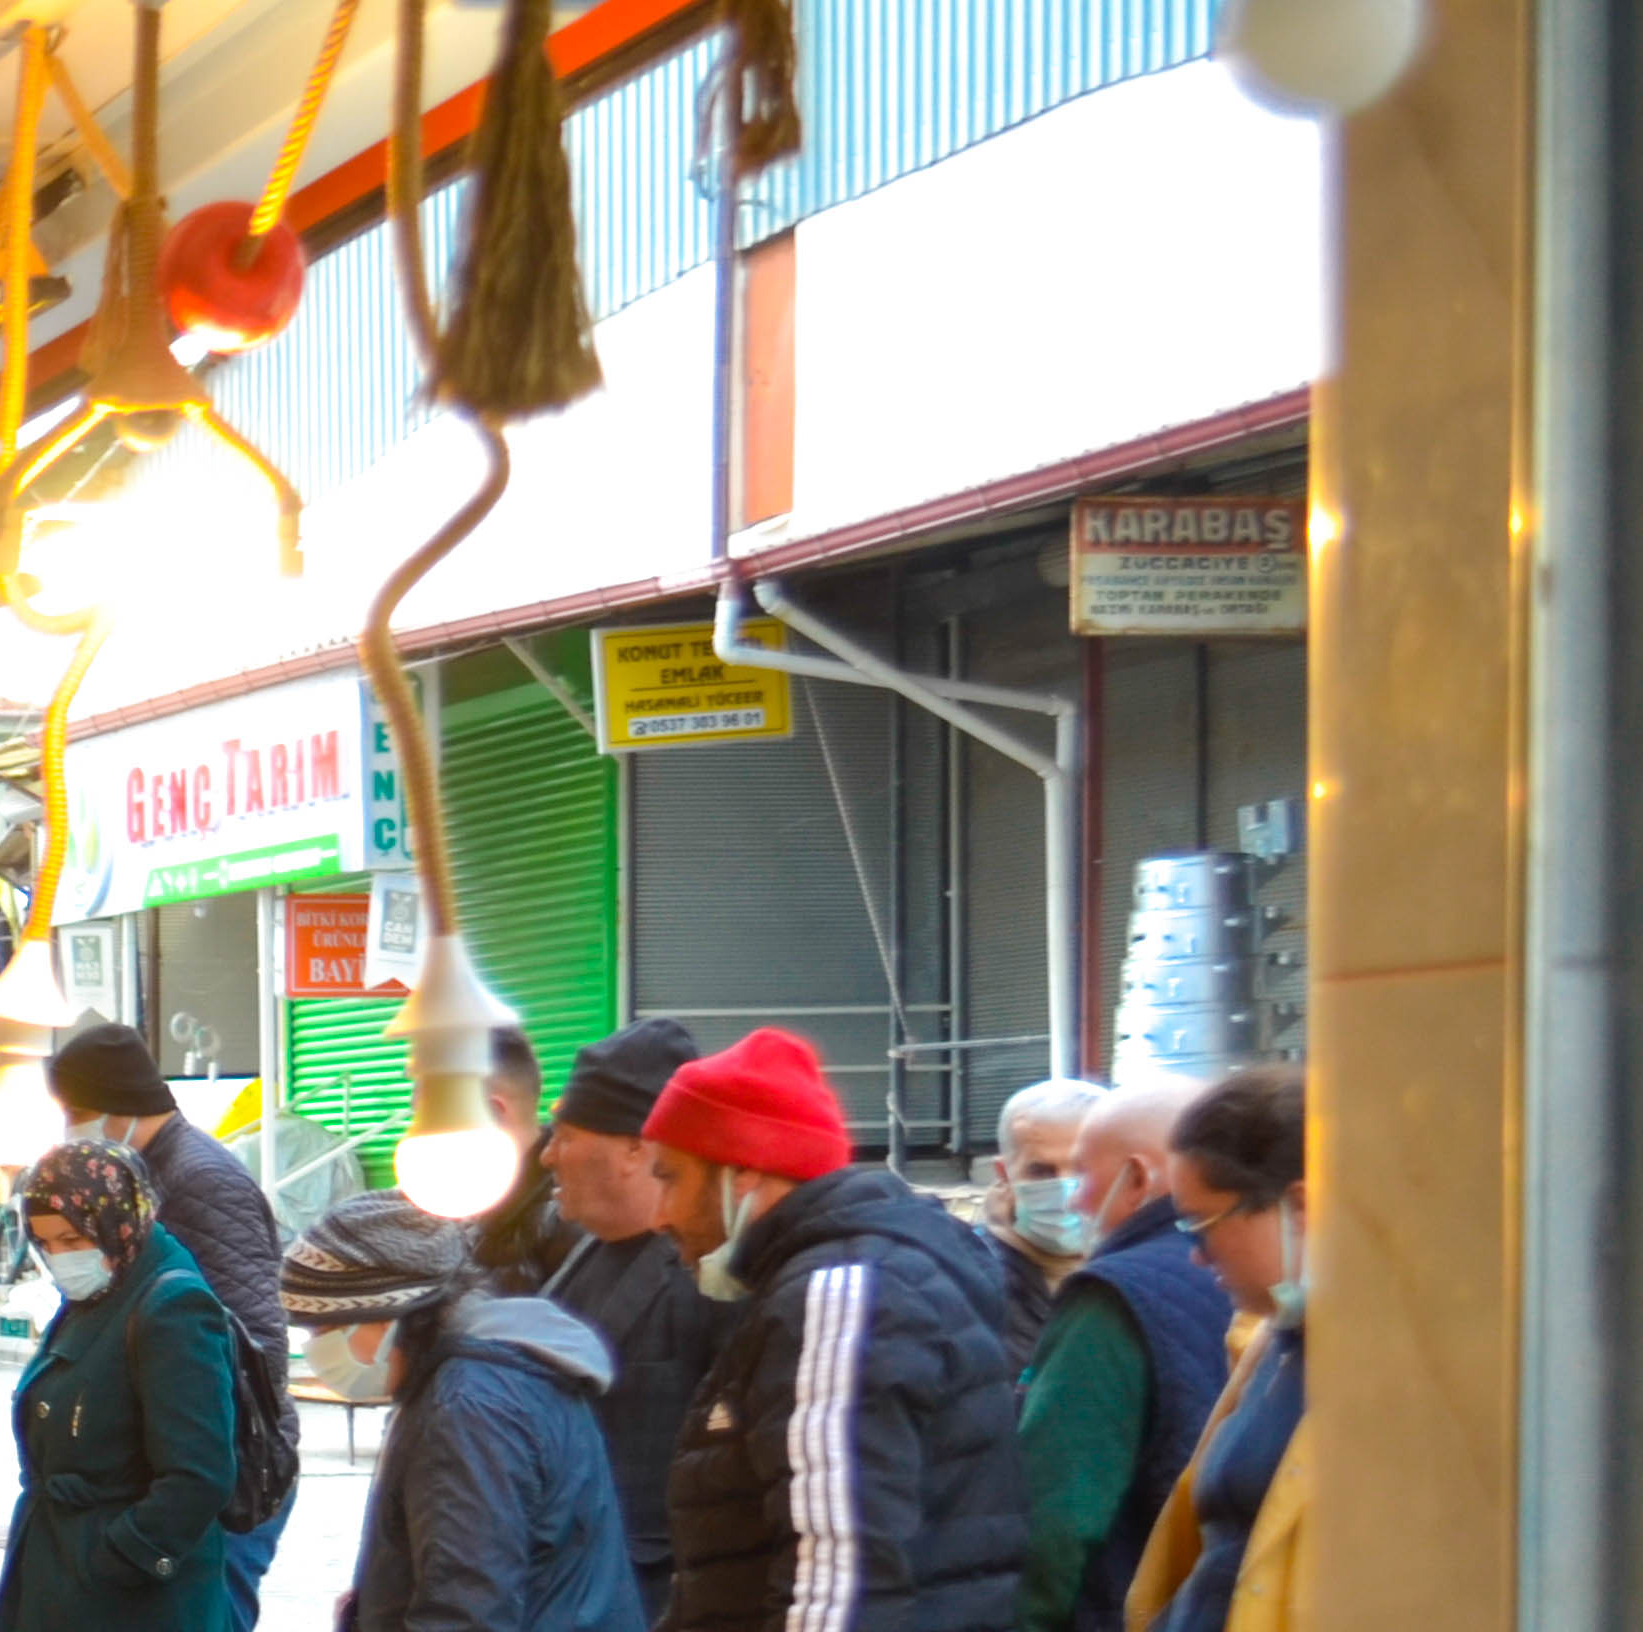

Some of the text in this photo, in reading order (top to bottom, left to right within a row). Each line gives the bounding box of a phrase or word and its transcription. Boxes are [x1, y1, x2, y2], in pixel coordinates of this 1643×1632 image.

[1083, 507, 1292, 549] KARABAŞ
[617, 642, 683, 663] KONUT
[660, 665, 724, 685] EMLAK
[125, 729, 340, 844] GENÇ TARIM
